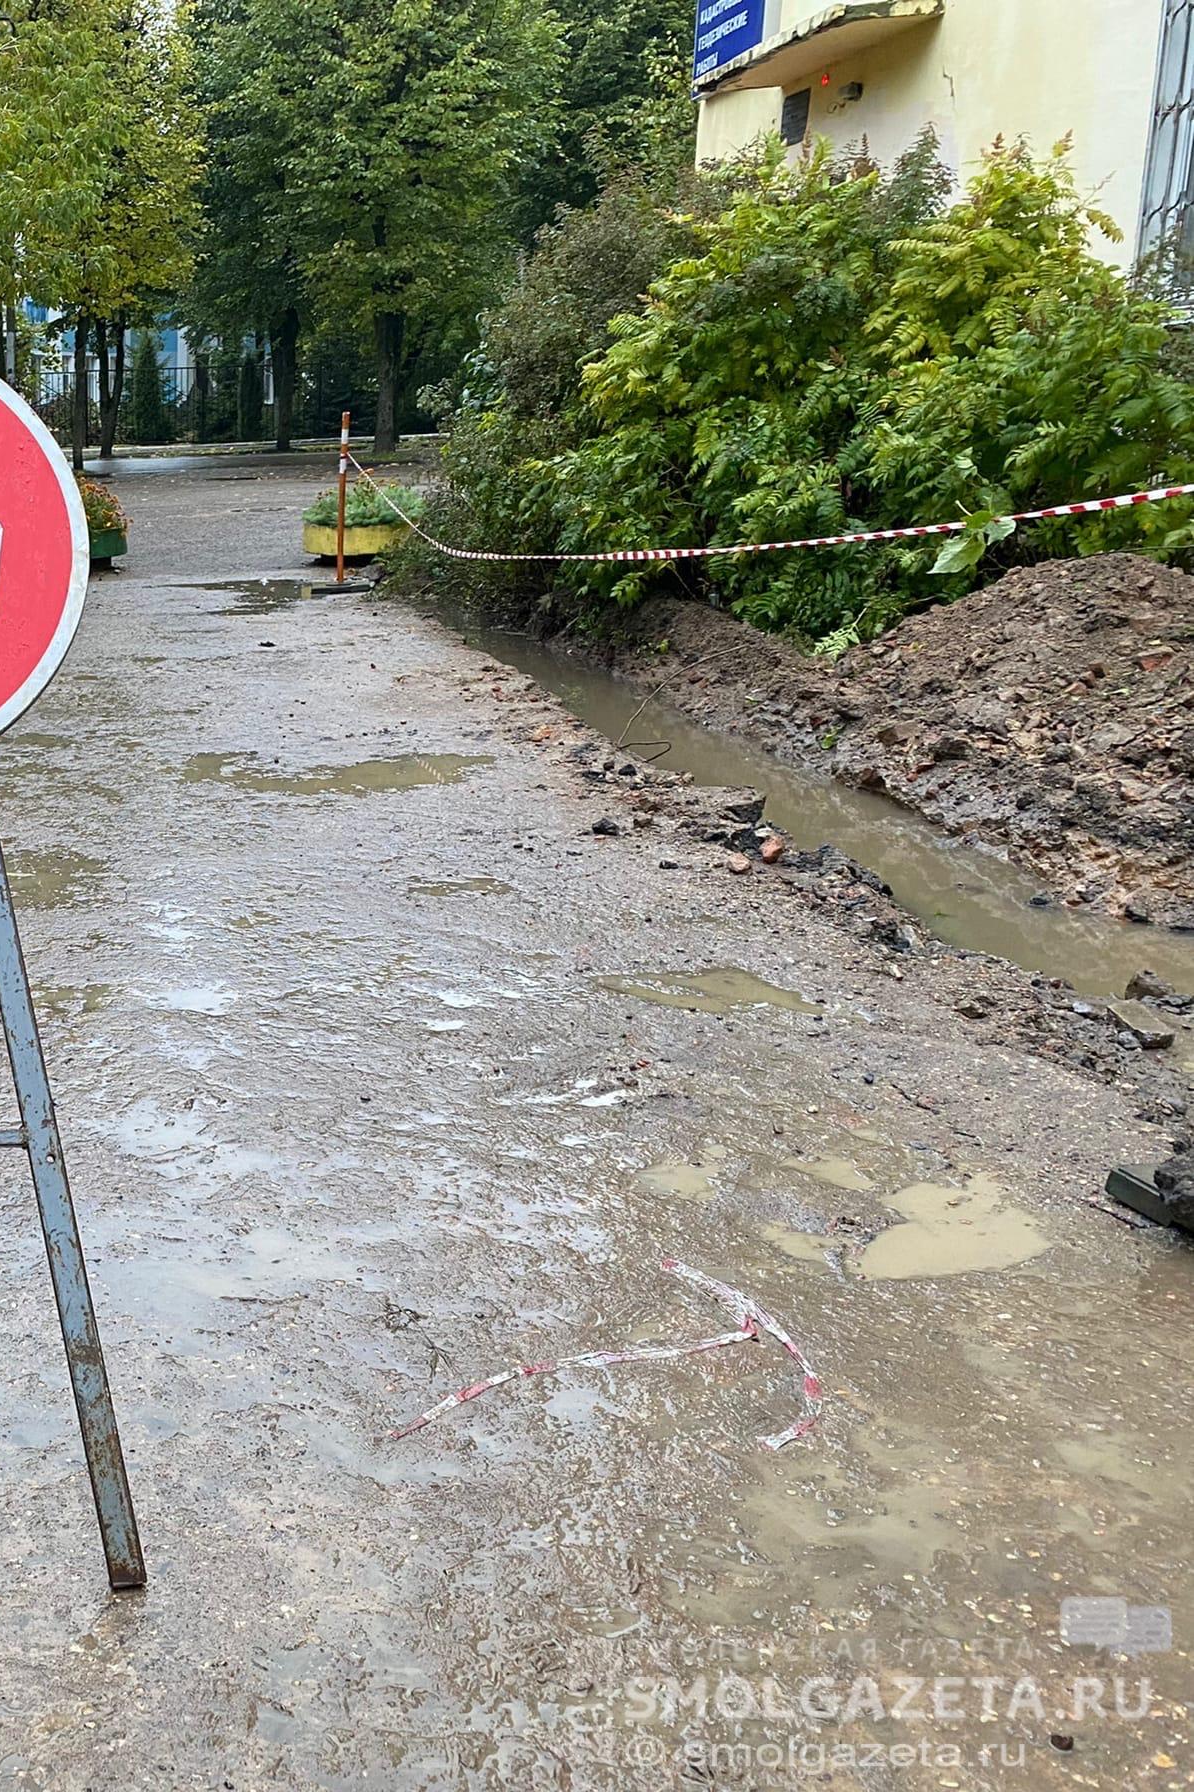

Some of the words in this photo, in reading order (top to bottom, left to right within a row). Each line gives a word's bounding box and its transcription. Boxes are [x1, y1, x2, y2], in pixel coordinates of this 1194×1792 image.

[700, 0, 743, 25] КАДАСТРО
[698, 10, 748, 52] ГЕОДЕЗИЧЕСКИЕ
[696, 51, 718, 77] РАБОТЫ
